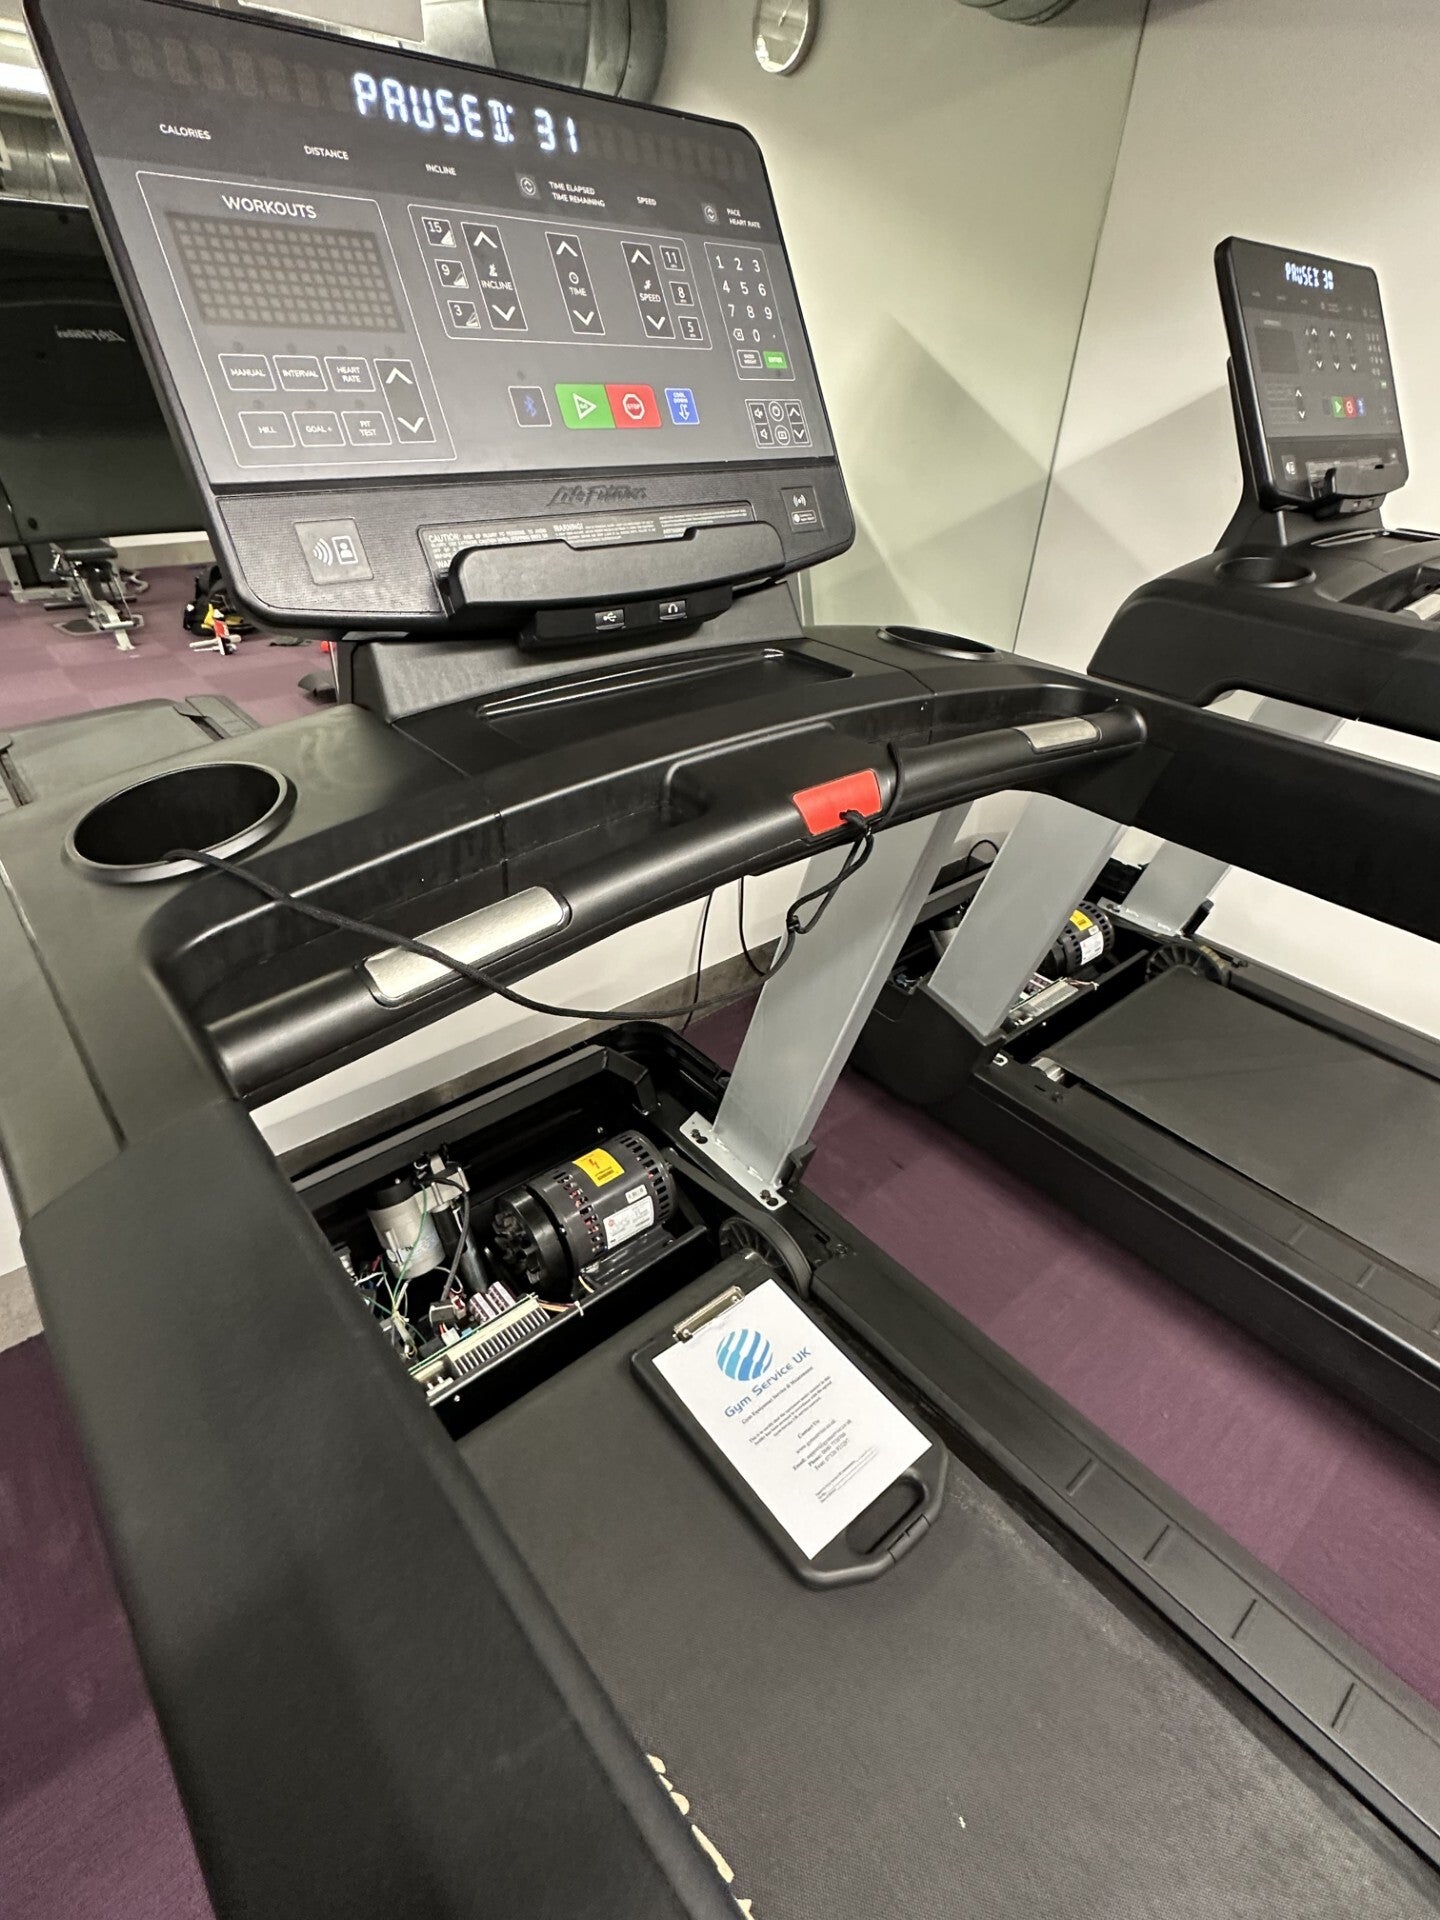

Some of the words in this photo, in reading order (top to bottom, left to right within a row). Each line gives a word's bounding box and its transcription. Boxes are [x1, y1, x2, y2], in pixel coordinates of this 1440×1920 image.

[160, 123, 212, 140] CALORIES
[534, 108, 579, 153] 31
[304, 145, 350, 160] DISTANCE
[425, 163, 457, 176] INCLINE
[549, 181, 565, 192] TIME
[566, 183, 595, 195] ELAPSED
[553, 192, 568, 203] TIME
[636, 195, 657, 206] SPEED
[221, 195, 318, 218] WORKOUTS
[427, 221, 443, 233] 15
[664, 251, 677, 264] 11
[715, 254, 725, 270] 1
[734, 257, 743, 271] 2
[441, 264, 450, 276] 9
[752, 259, 761, 273] 3
[480, 280, 514, 291] INCLINE
[569, 286, 588, 297] TIME
[677, 285, 685, 299] 8
[722, 280, 731, 294] 4
[740, 281, 749, 295] 5
[758, 283, 767, 297] 6
[639, 292, 661, 303] SPEED
[454, 304, 463, 317] 3
[728, 304, 736, 317] 7
[746, 306, 755, 319] 8
[764, 307, 773, 320] 9
[687, 321, 695, 334] 5
[752, 329, 761, 343] 0
[230, 368, 267, 377] MANUAL
[282, 369, 319, 379] INTERVAL
[337, 366, 361, 375] HEART
[341, 375, 362, 384] RATE
[258, 426, 277, 434] HILL
[359, 428, 377, 437] TEST
[724, 1396, 751, 1417] Gym
[752, 1363, 793, 1396] Service
[792, 1347, 811, 1363] UK
